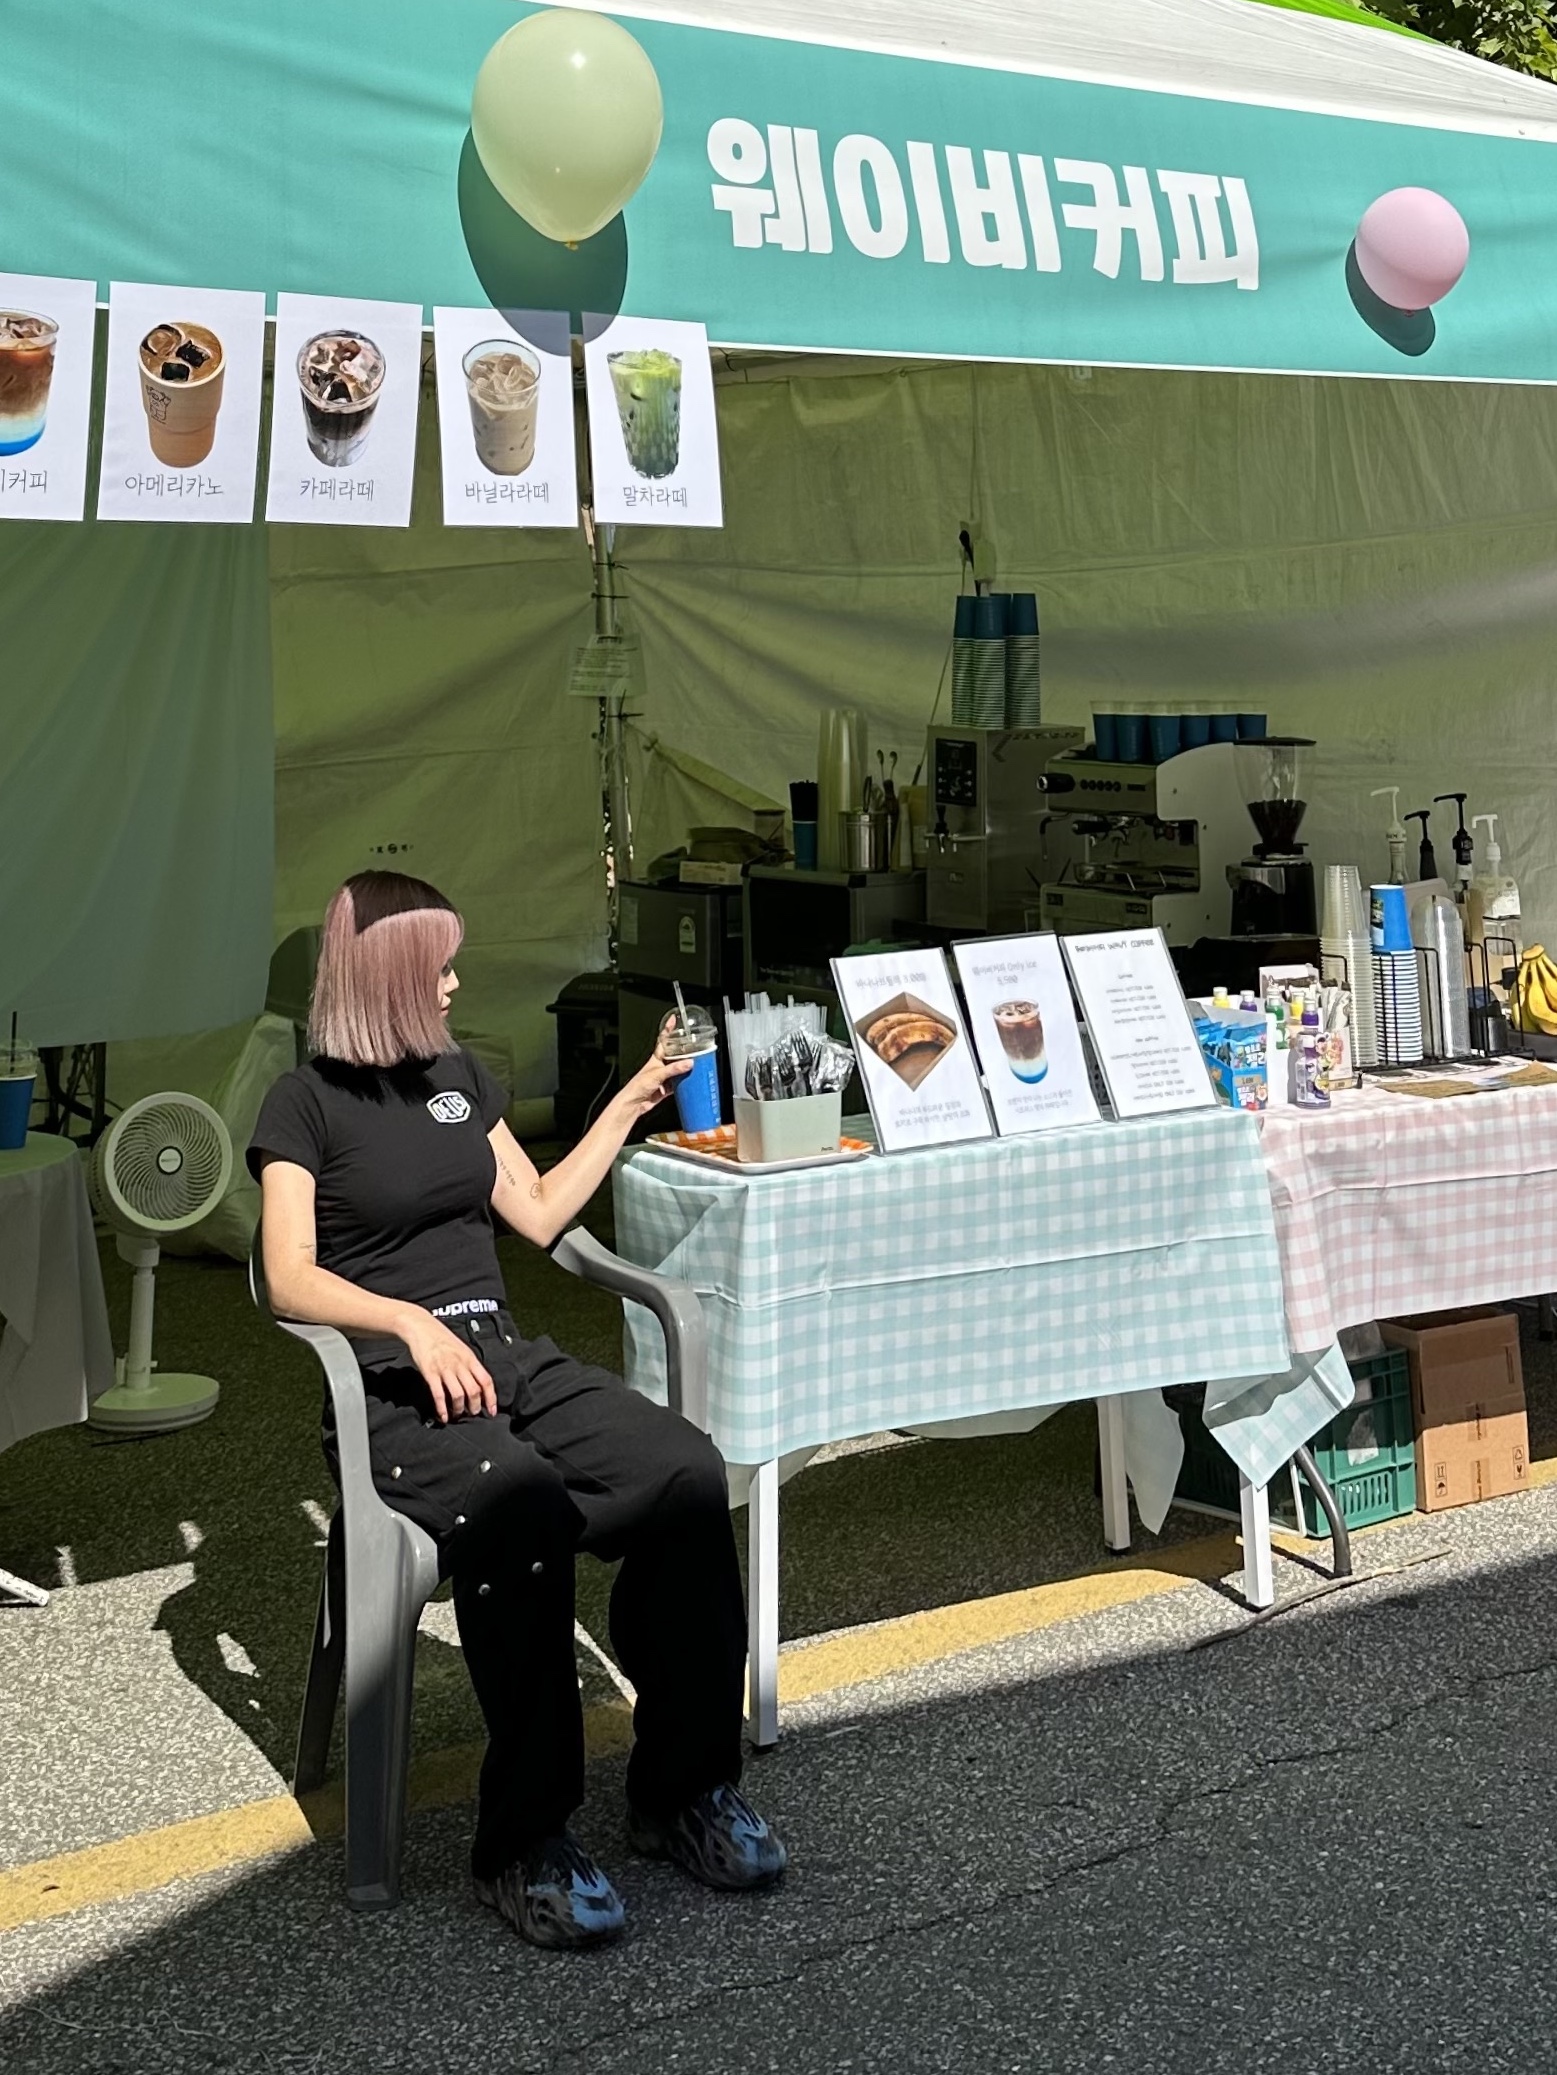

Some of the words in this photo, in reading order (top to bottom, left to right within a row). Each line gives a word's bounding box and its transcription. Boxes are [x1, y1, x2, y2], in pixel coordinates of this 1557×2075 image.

[707, 118, 1261, 290] 웨이비커피
[124, 473, 224, 498] 아메리카노
[300, 477, 375, 502] 카페라떼
[464, 482, 549, 505] 바닐라라떼
[622, 486, 688, 508] 말차라떼
[430, 1096, 467, 1120] DEUS
